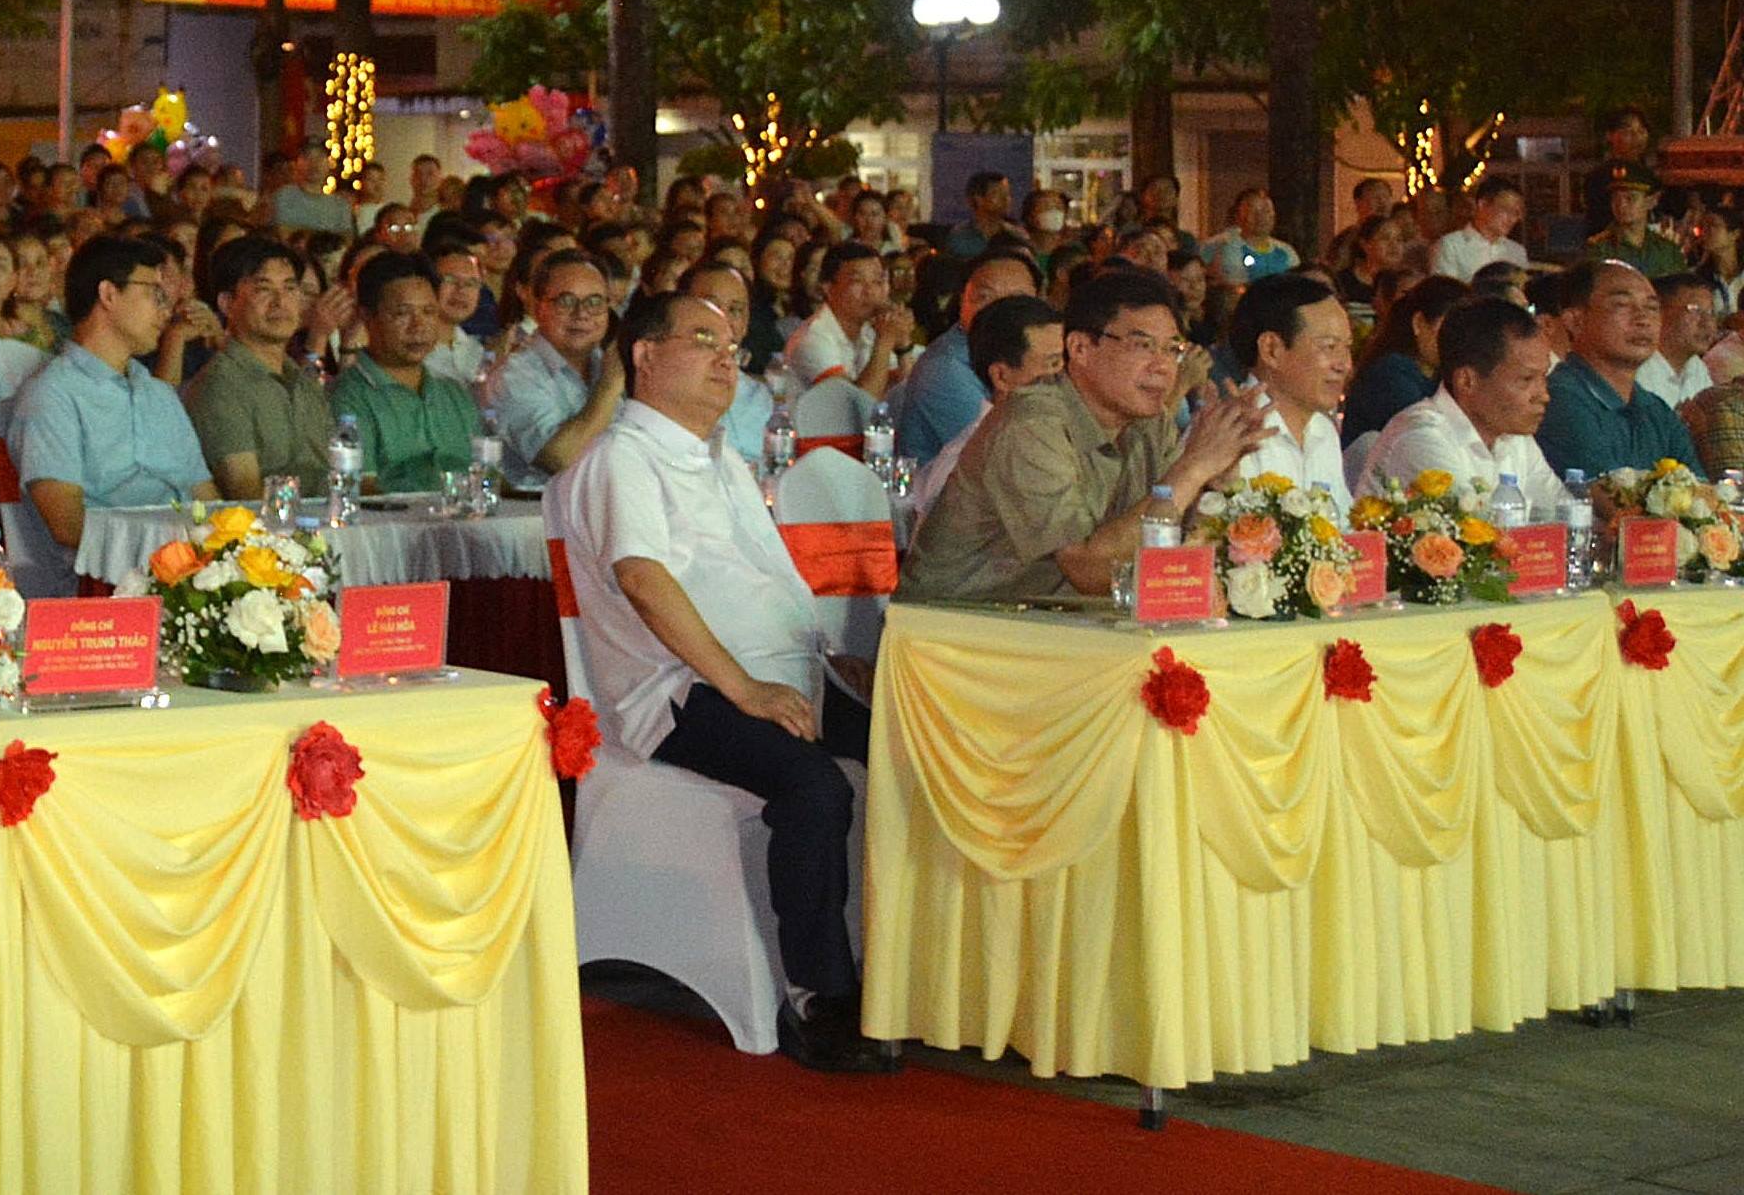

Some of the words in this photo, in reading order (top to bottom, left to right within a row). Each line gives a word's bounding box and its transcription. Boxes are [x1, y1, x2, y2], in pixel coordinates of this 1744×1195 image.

[98, 617, 114, 631] CHÍ
[31, 632, 78, 651] NGUYỄN
[79, 635, 116, 649] TRUNG
[118, 631, 149, 648] THẢO
